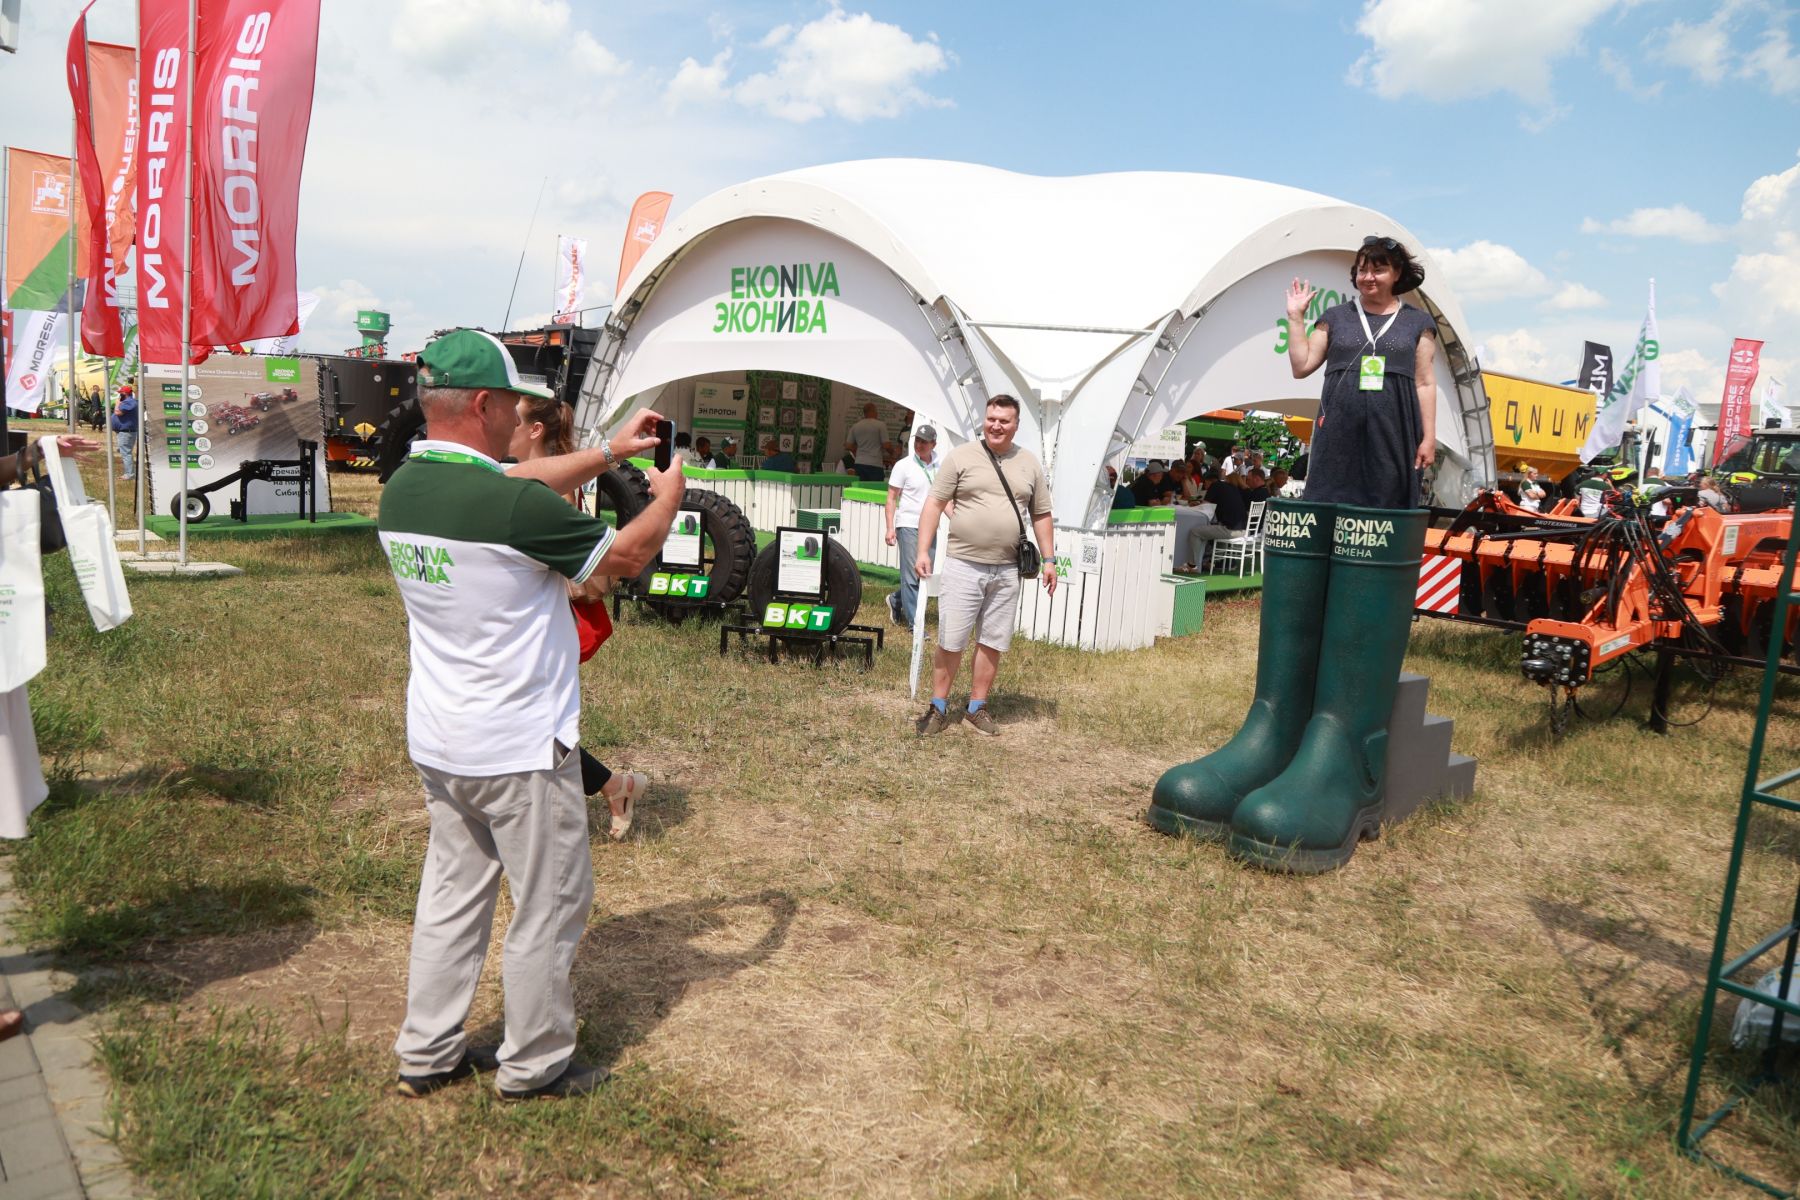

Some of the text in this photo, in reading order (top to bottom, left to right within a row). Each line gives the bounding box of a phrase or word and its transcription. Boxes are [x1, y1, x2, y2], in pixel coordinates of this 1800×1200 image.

[221, 11, 271, 286] MORRIS
[142, 47, 181, 309] MORRIS
[731, 262, 840, 300] EKONIVA
[712, 299, 827, 334] ЭКОНИВА
[698, 407, 737, 416] ЭН ПРОТОН
[1487, 397, 1588, 440] ONUM
[389, 541, 455, 566] EKONIVA
[1334, 545, 1372, 558] СЕМЕНА
[651, 577, 708, 593] BKT
[765, 607, 831, 626] BKT
